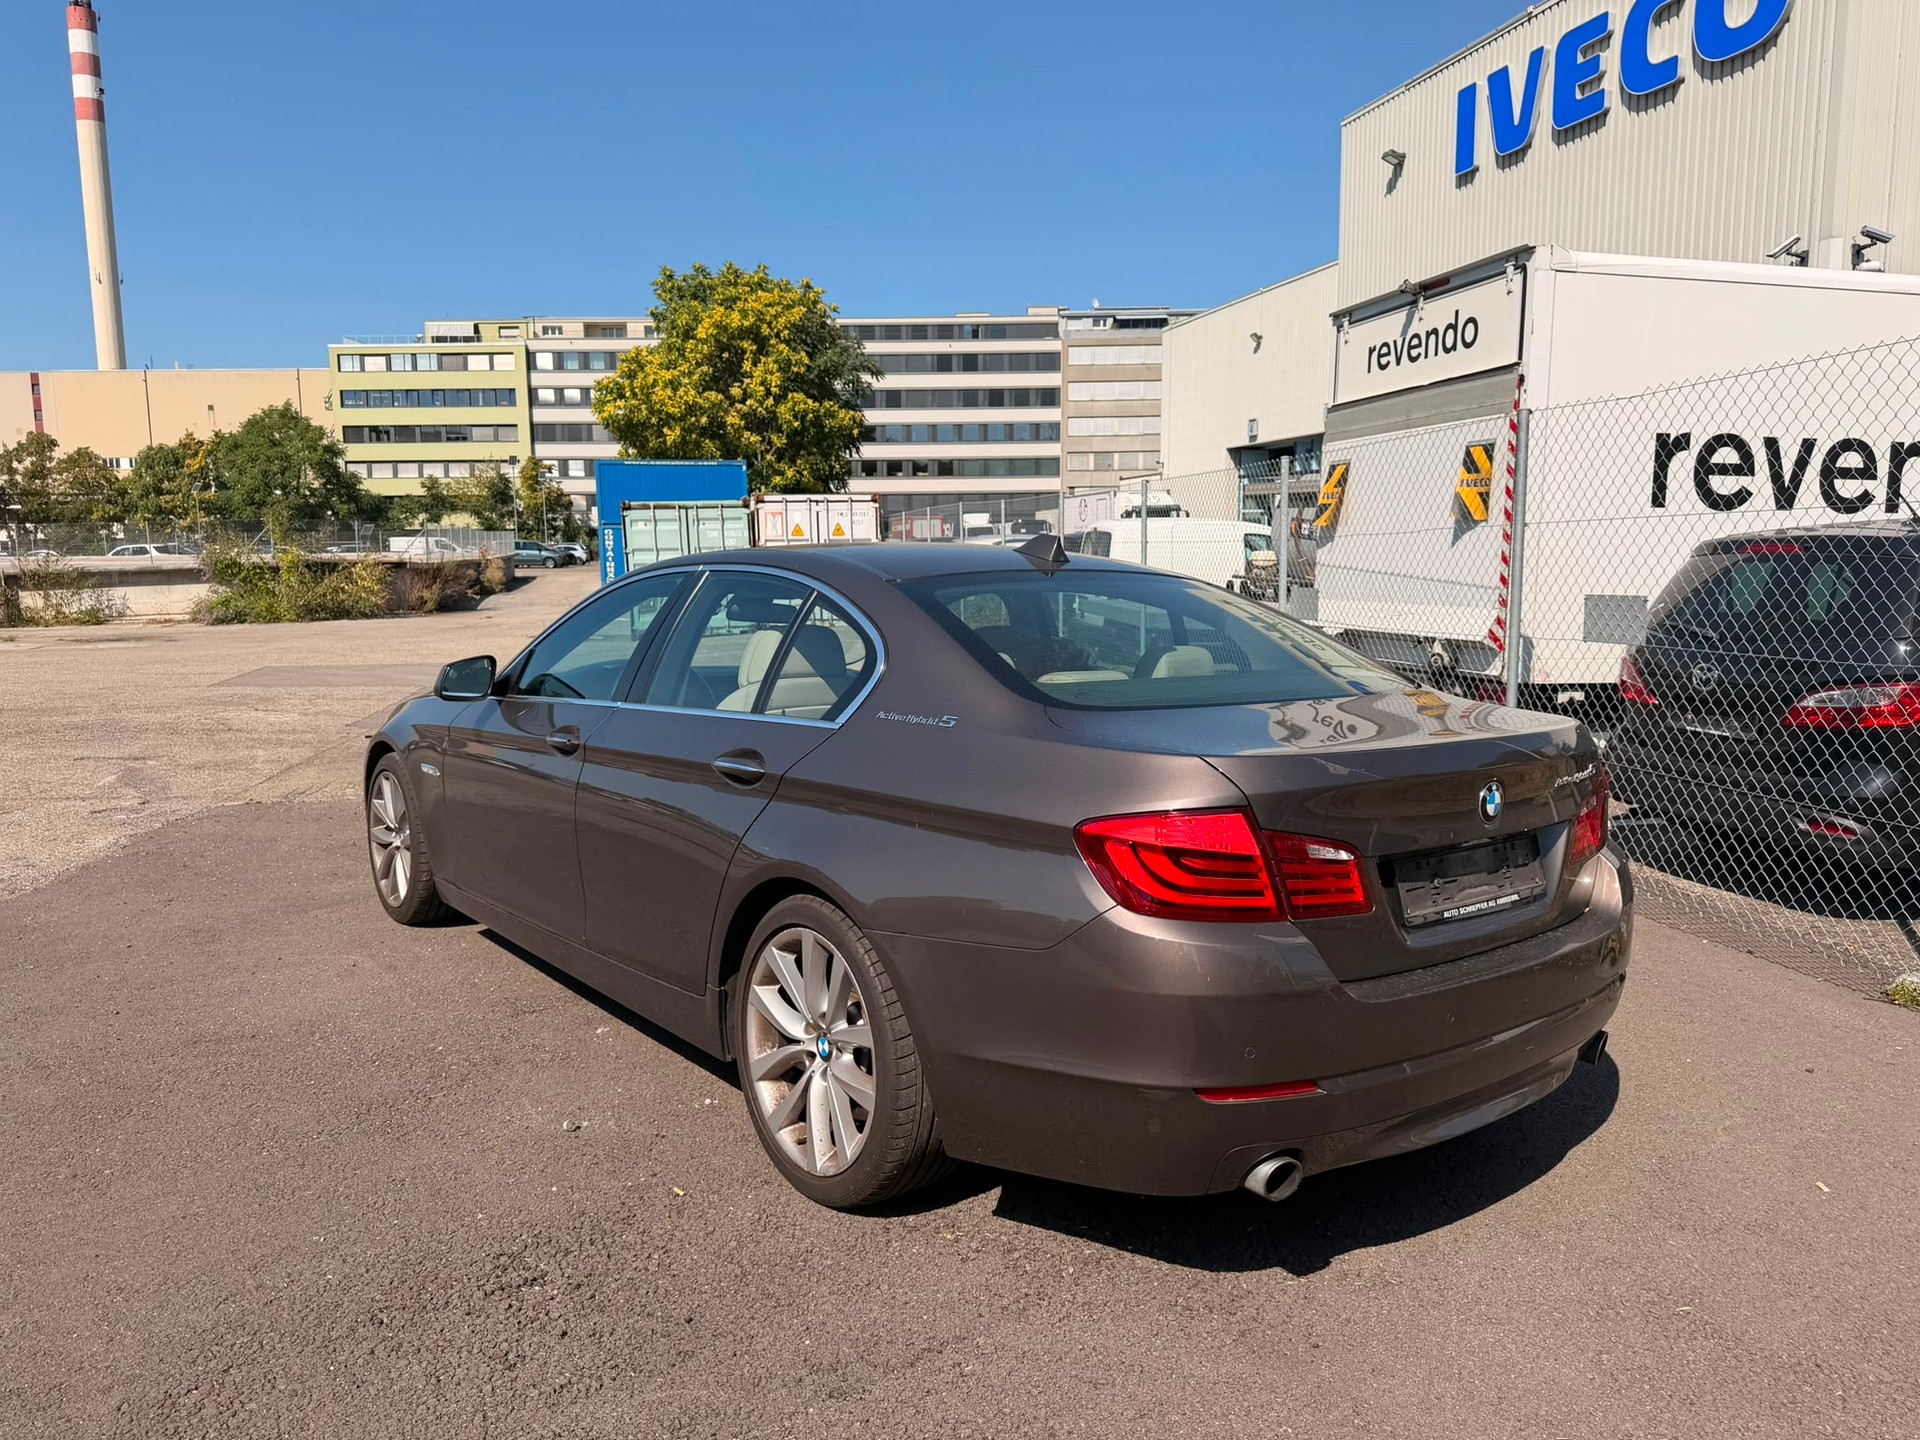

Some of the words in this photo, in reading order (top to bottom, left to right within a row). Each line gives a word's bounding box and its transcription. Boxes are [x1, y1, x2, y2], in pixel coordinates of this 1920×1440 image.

[1455, 0, 1793, 176] IVECO
[1367, 309, 1479, 374] revendo
[1459, 477, 1491, 488] IVECO
[1322, 491, 1341, 500] IVEC
[939, 715, 959, 728] 5
[1443, 908, 1459, 918] AUTO
